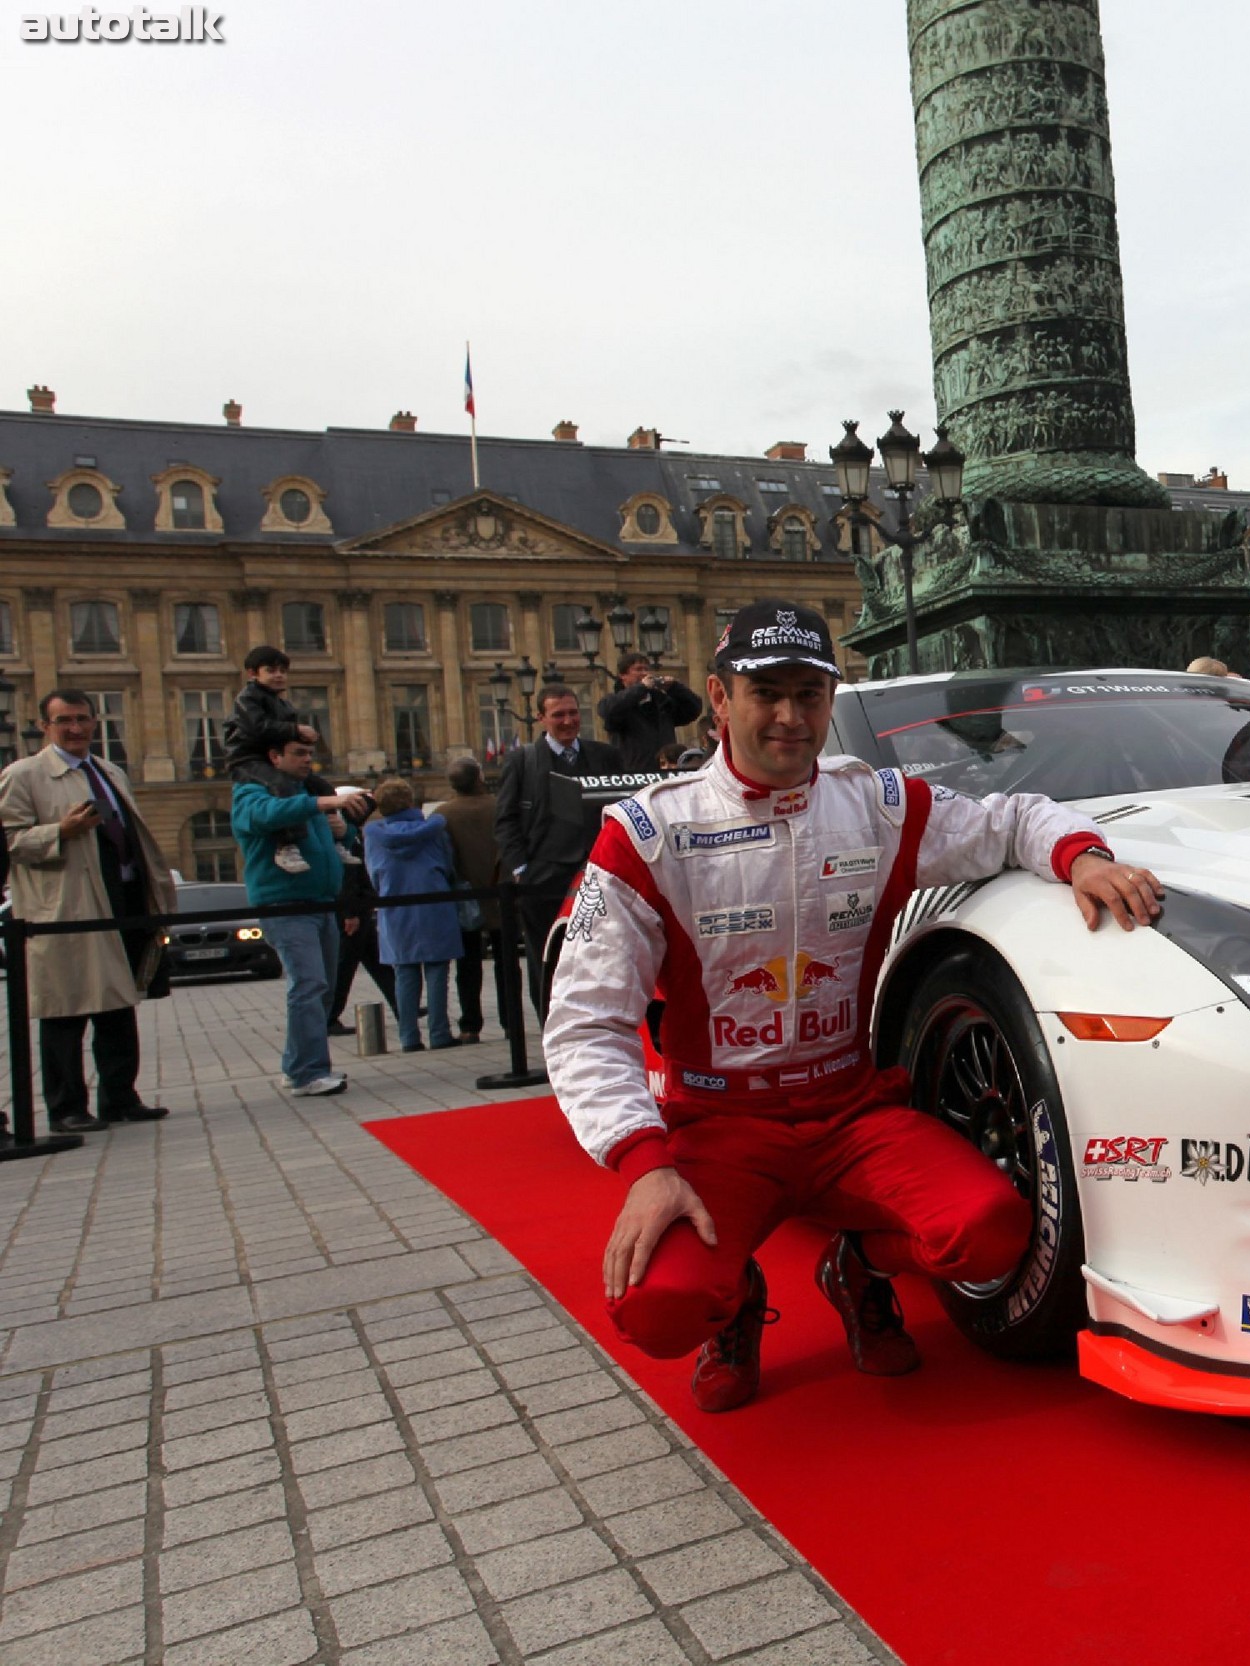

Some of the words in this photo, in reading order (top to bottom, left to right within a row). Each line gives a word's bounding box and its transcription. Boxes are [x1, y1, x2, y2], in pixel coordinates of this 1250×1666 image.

[751, 626, 821, 643] REMUS
[621, 799, 655, 837] sparco
[694, 826, 770, 845] MICHELIN
[699, 908, 773, 925] SPEED
[828, 904, 873, 922] REMUS
[700, 921, 756, 934] WEEK
[712, 1011, 784, 1047] Red
[799, 998, 851, 1042] Bull
[683, 1071, 726, 1088] sparco
[1105, 1136, 1169, 1165] SRT
[1008, 1159, 1059, 1323] MICHELIN
